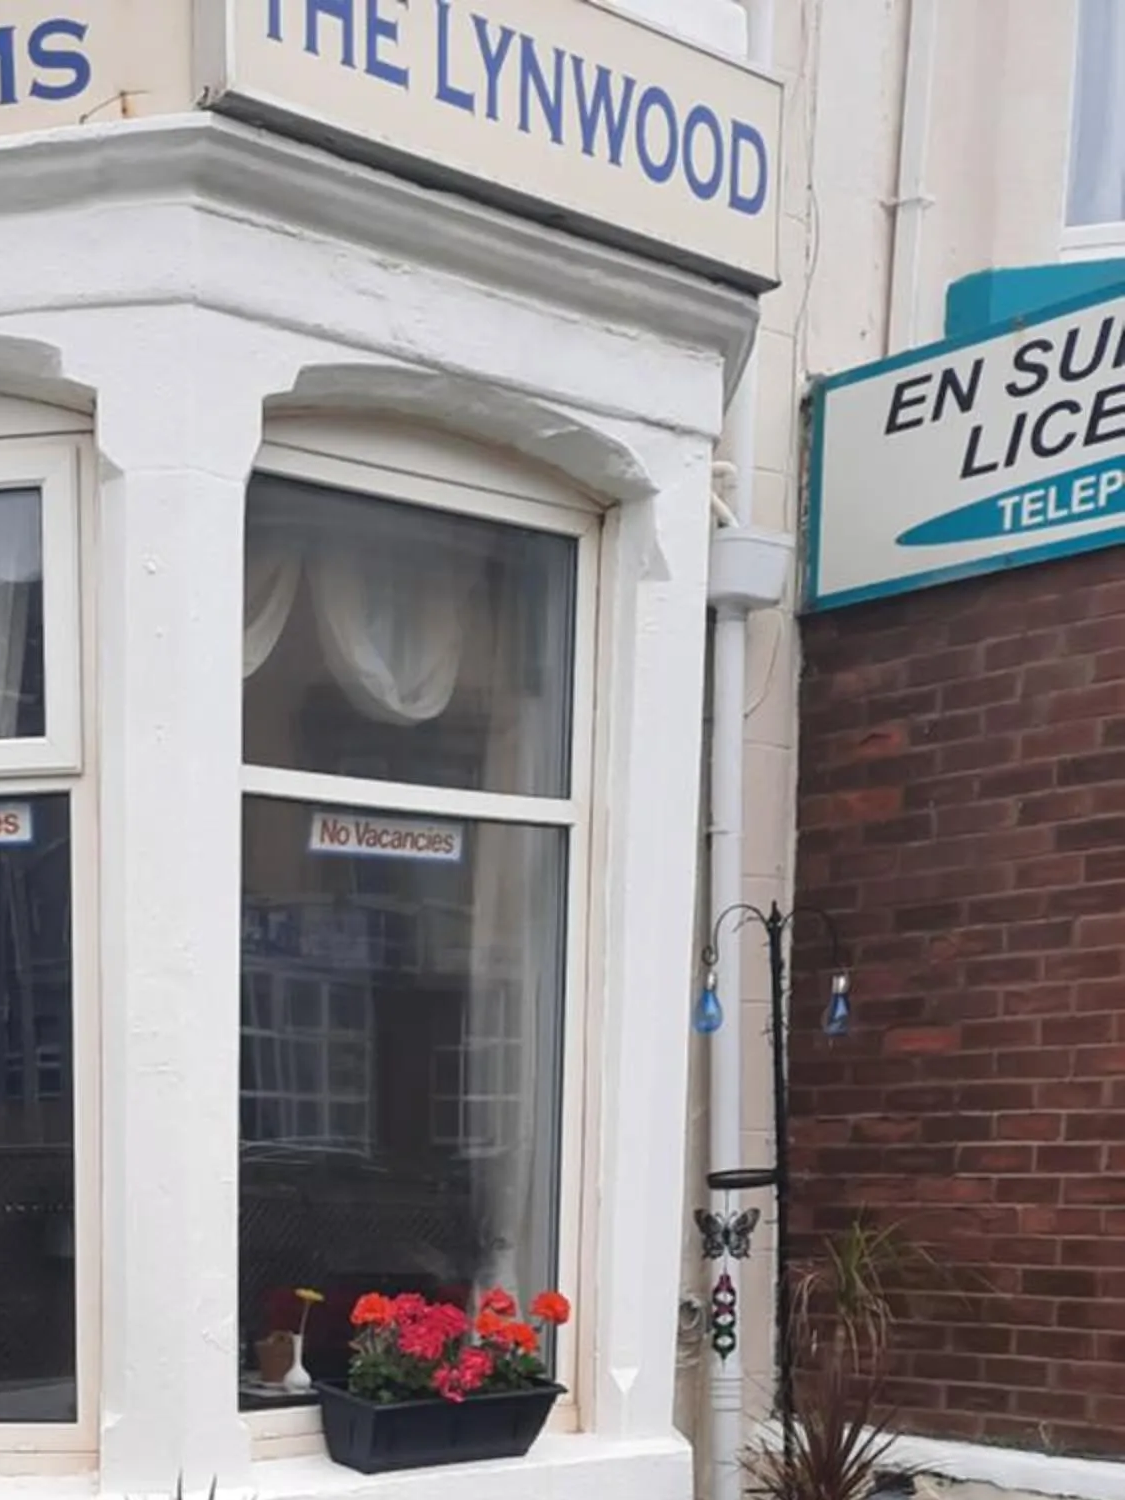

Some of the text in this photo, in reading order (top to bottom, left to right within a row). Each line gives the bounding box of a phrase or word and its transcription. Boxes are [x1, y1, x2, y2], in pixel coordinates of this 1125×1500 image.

[433, 0, 769, 216] LYNWOOD
[884, 358, 985, 436] EN
[960, 383, 1125, 479] LICE
[997, 469, 1125, 531] TELEP
[319, 818, 455, 854] No Vacancies
